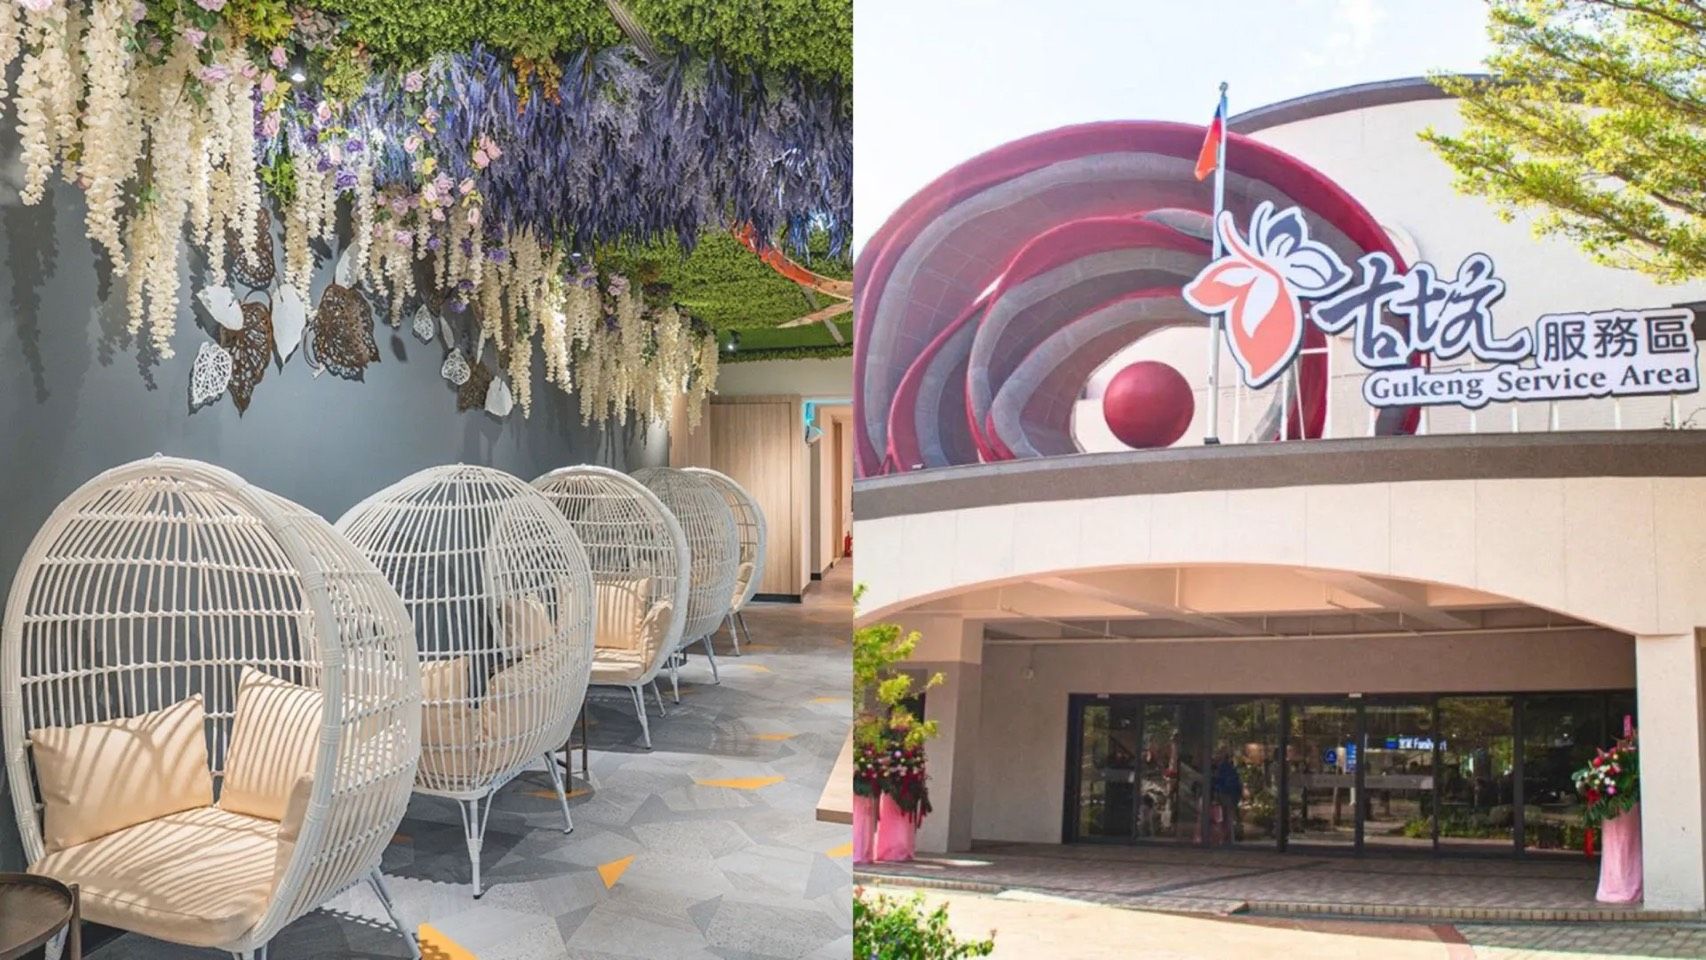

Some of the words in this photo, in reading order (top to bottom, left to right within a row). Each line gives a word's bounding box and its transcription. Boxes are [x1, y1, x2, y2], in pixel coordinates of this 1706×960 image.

[1543, 315, 1691, 362] 服務區
[1370, 375, 1485, 401] Gukeng
[1496, 368, 1607, 393] Service
[1620, 364, 1691, 386] Area
